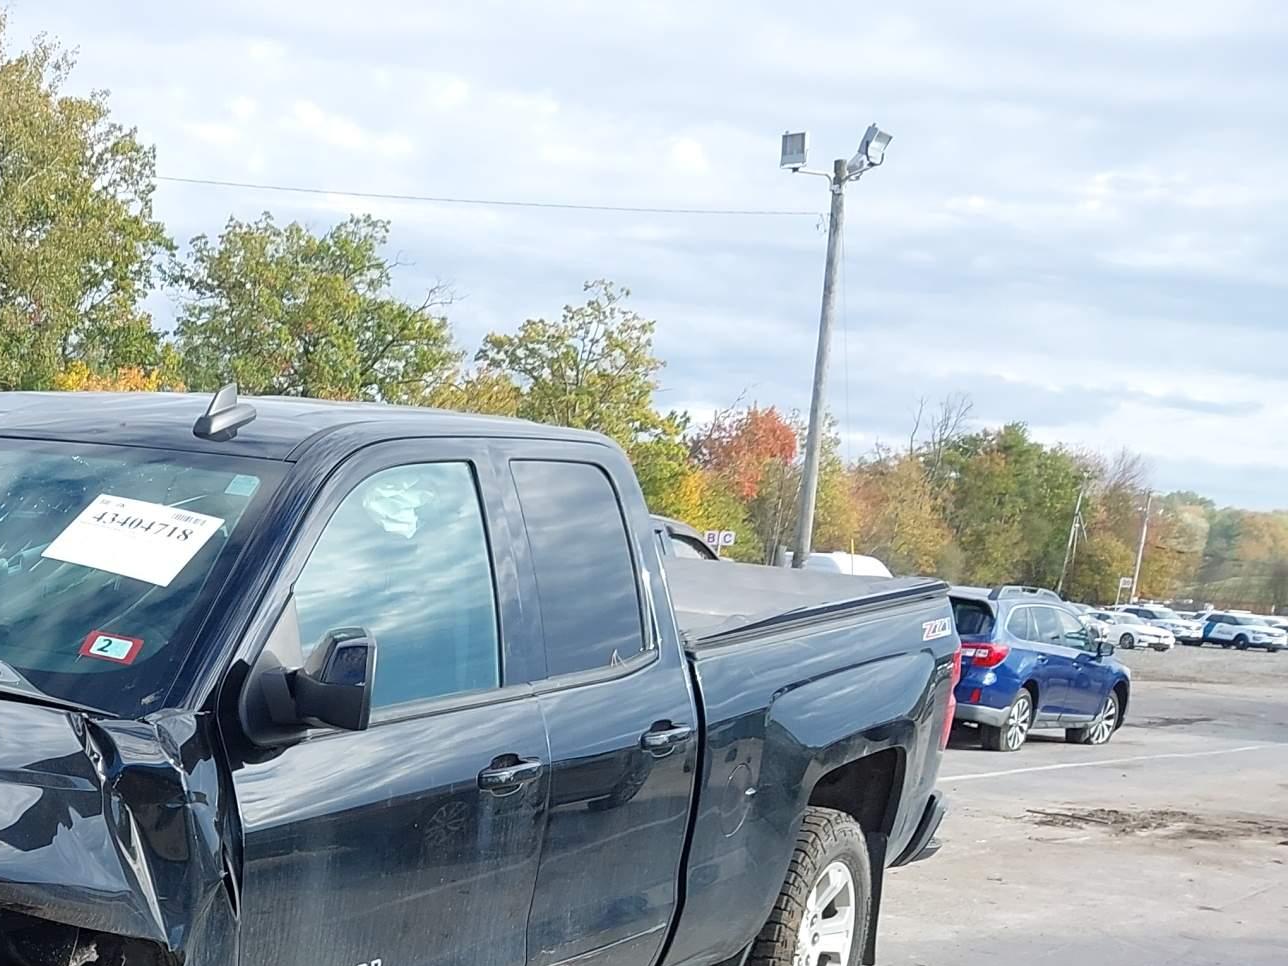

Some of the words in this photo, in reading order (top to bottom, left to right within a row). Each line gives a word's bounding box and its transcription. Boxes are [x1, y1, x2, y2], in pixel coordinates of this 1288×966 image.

[93, 510, 195, 543] 43404718
[707, 532, 716, 543] B
[723, 533, 732, 544] C
[97, 638, 113, 653] 2
